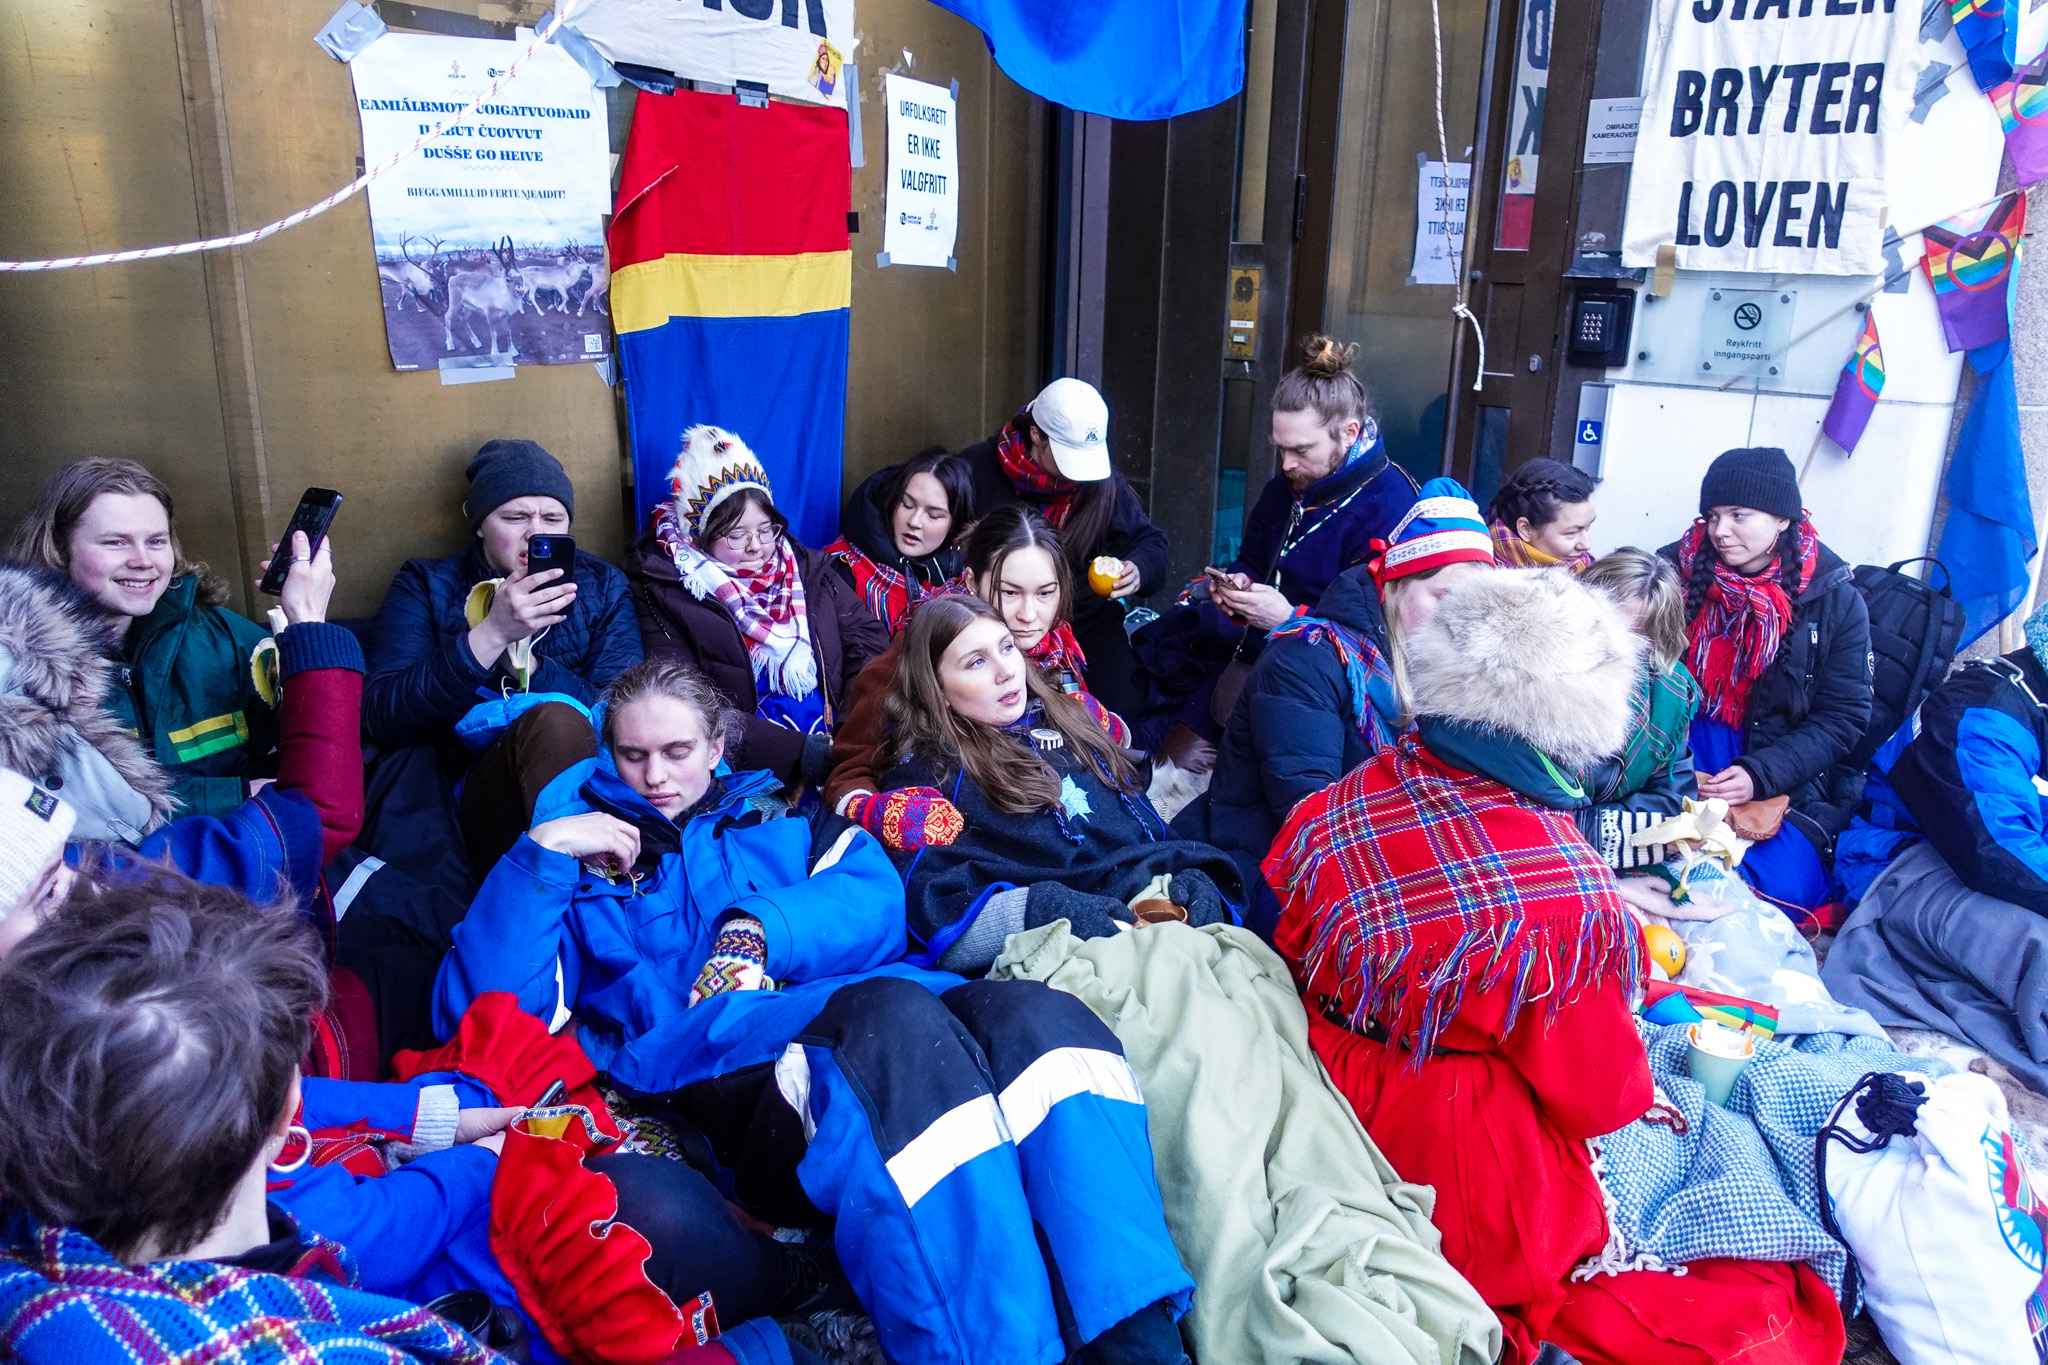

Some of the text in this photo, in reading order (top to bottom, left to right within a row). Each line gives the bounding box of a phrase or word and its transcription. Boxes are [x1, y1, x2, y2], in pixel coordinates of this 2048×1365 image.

[360, 97, 591, 119] EAMIÁLBMOTUOIGATVUOĐAID
[1669, 62, 1886, 137] BRYTER
[900, 100, 947, 126] URFOLKSRETT
[478, 124, 543, 139] ČUOVVUT
[423, 145, 543, 162] DUŠŠE GO HEIVE
[907, 133, 941, 159] ER IKKE
[407, 187, 488, 198] BIEGGAMILLUID
[490, 189, 520, 198] FERTE
[901, 168, 947, 195] VALGFRITT
[1675, 180, 1849, 249] LOVEN
[1726, 338, 1762, 349] Røykfritt
[1713, 349, 1771, 361] inngangsparti
